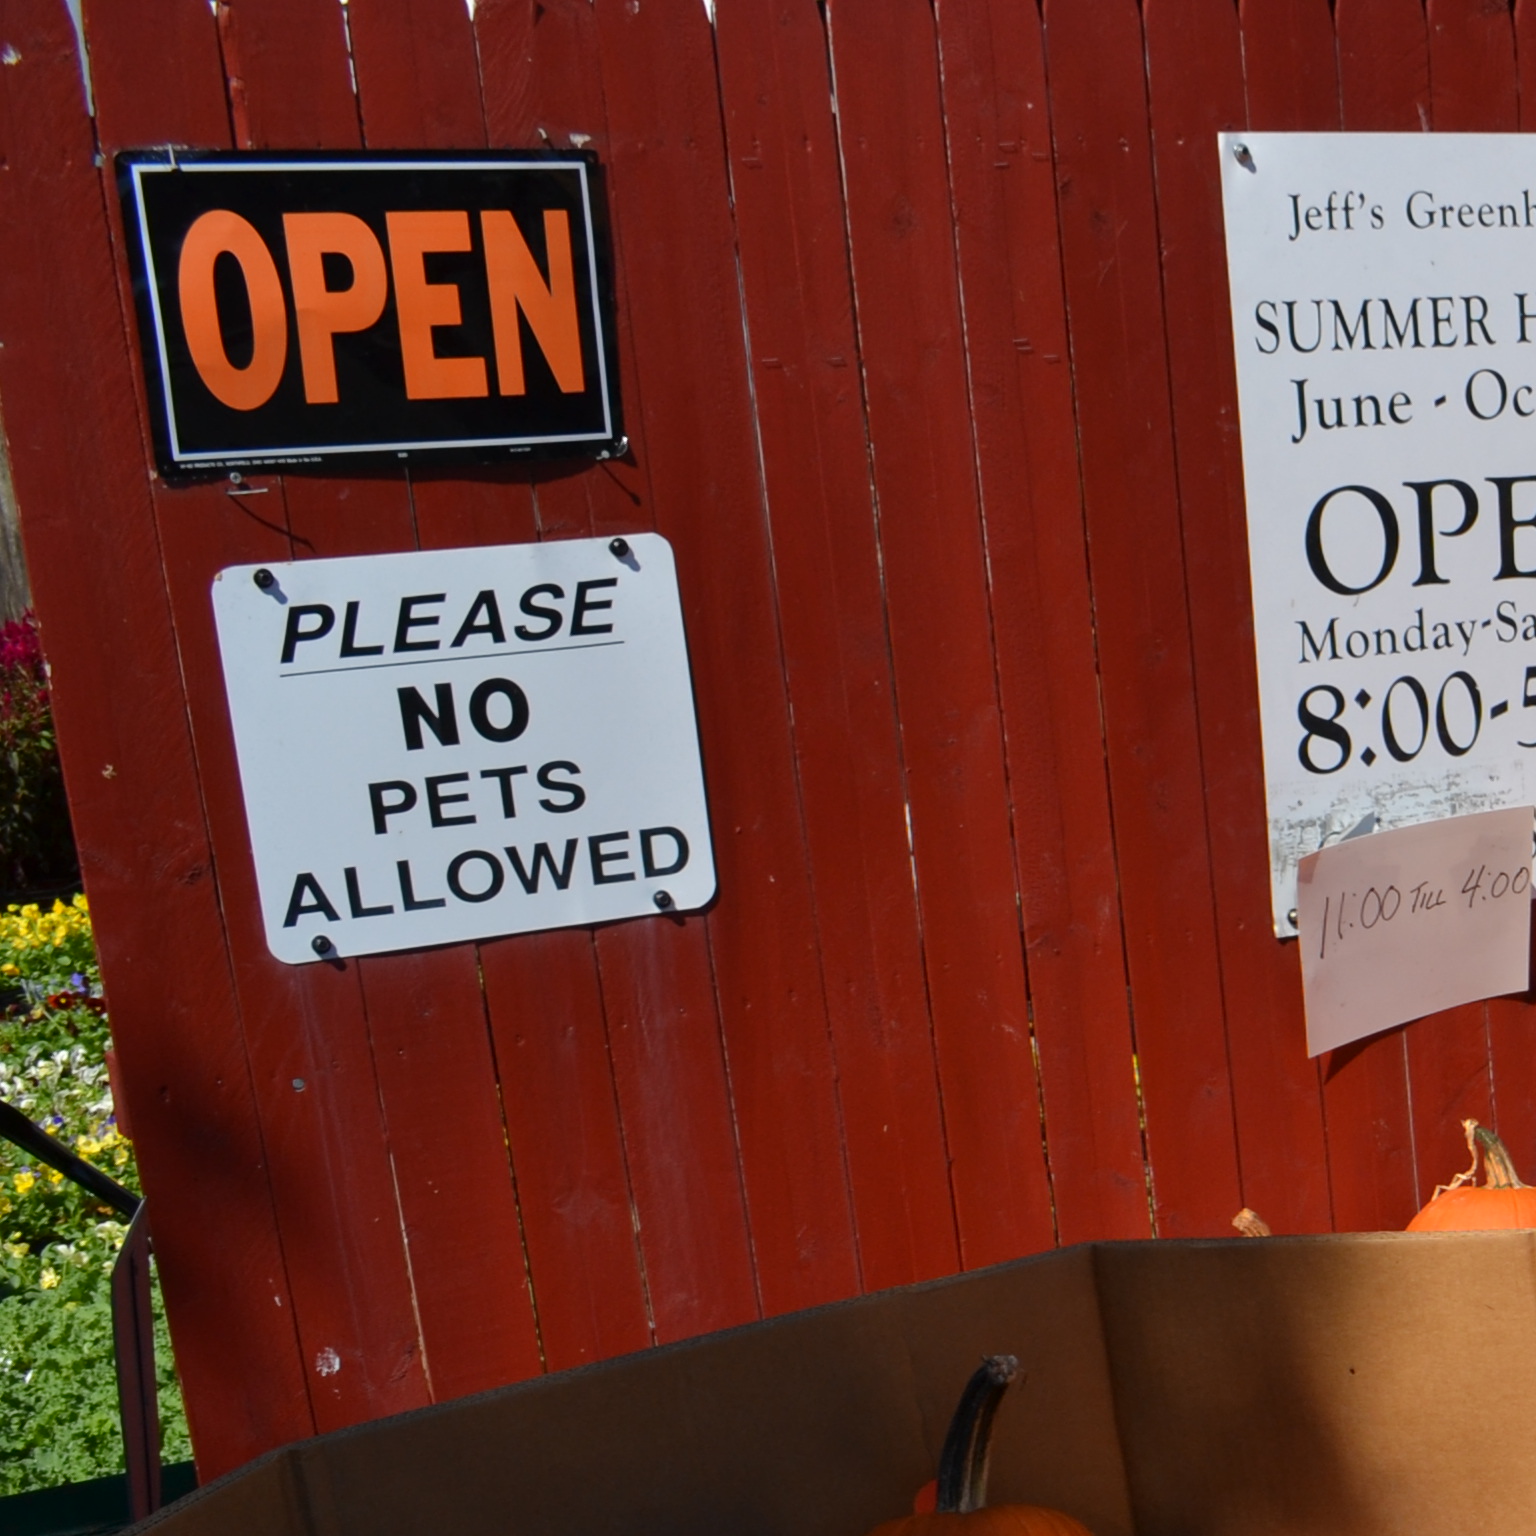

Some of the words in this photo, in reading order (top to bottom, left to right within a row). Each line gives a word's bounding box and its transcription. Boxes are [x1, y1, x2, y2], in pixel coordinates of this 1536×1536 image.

[1288, 191, 1384, 241] Jeff's
[178, 209, 586, 411] OPEN
[1255, 295, 1496, 354] SUMMER
[1291, 379, 1412, 444] June
[277, 577, 618, 664] PLEASE
[397, 677, 530, 751] NO
[368, 760, 586, 835] PETS
[282, 824, 690, 928] ALLOWED
[1319, 884, 1401, 960] 11:00
[1461, 864, 1530, 908] 4:00
